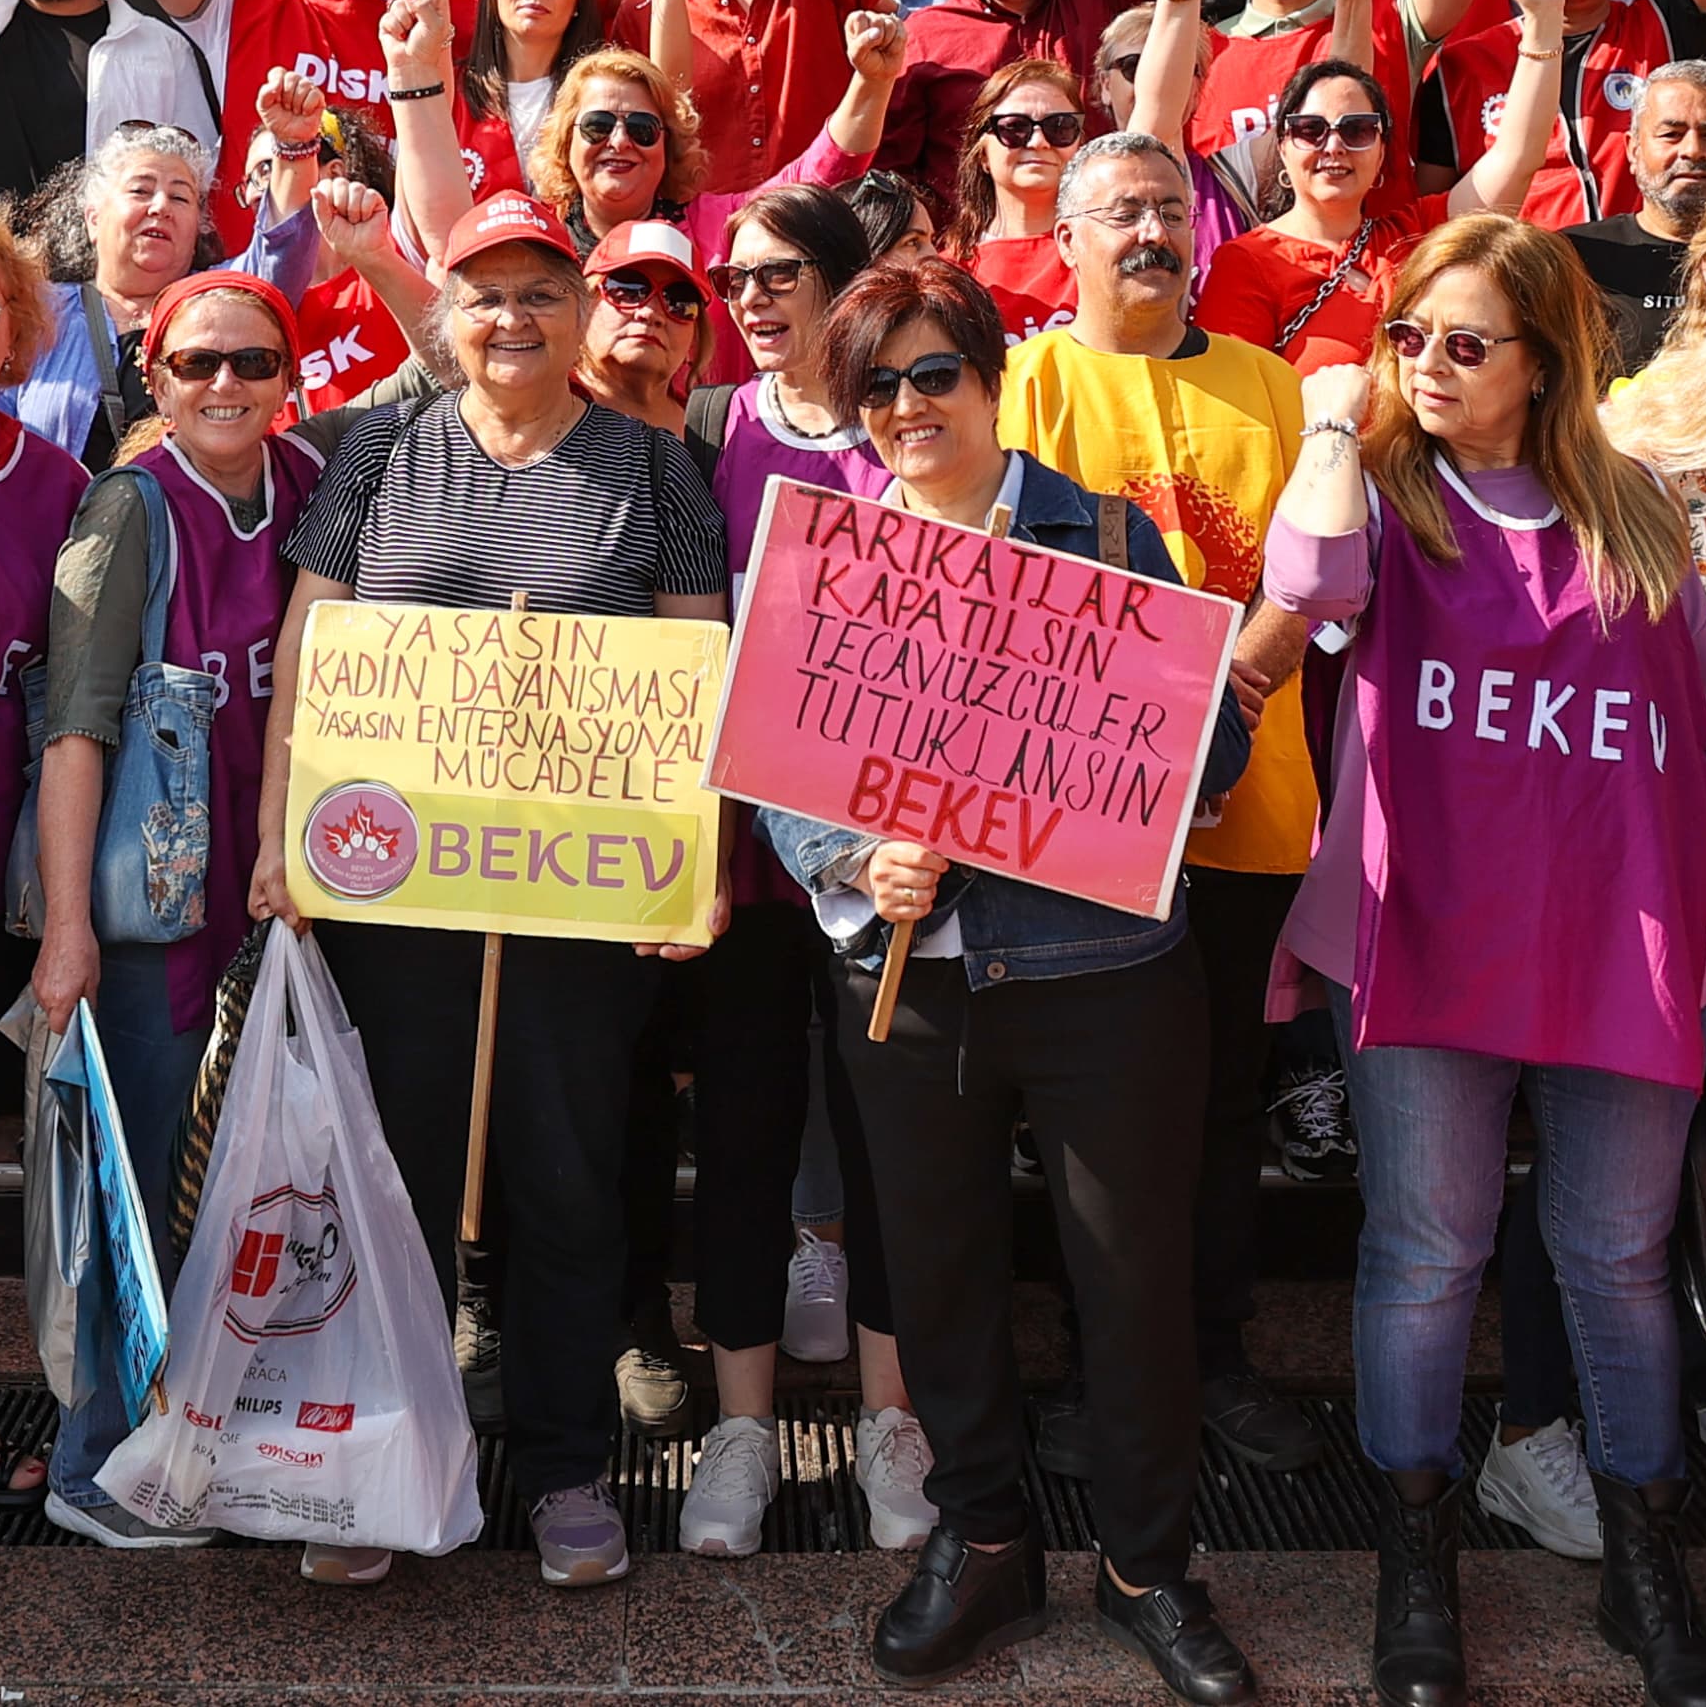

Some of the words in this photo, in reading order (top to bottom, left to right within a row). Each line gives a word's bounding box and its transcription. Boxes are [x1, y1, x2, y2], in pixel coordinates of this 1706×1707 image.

[1642, 294, 1686, 309] SITU
[796, 488, 1163, 643] TARİKATLAR
[376, 611, 608, 663] YAŞASIN
[812, 557, 1119, 683] KAPATILSIN
[308, 647, 427, 702] KADIN
[451, 655, 701, 720] DAYANIŞMASI
[805, 610, 1171, 763] TECAVÜZCÜLER
[1416, 657, 1669, 775] BEKEV
[305, 697, 406, 742] YAŞASIN
[416, 705, 705, 763] ENTERNASYONAL
[796, 667, 1171, 827] TUTUKLANSIN
[433, 748, 680, 803] MÜCADELE
[847, 755, 1064, 871] BEKEV
[428, 822, 685, 892] BEKEV
[234, 1396, 283, 1415] HILIPS
[256, 1442, 325, 1464] emsan
